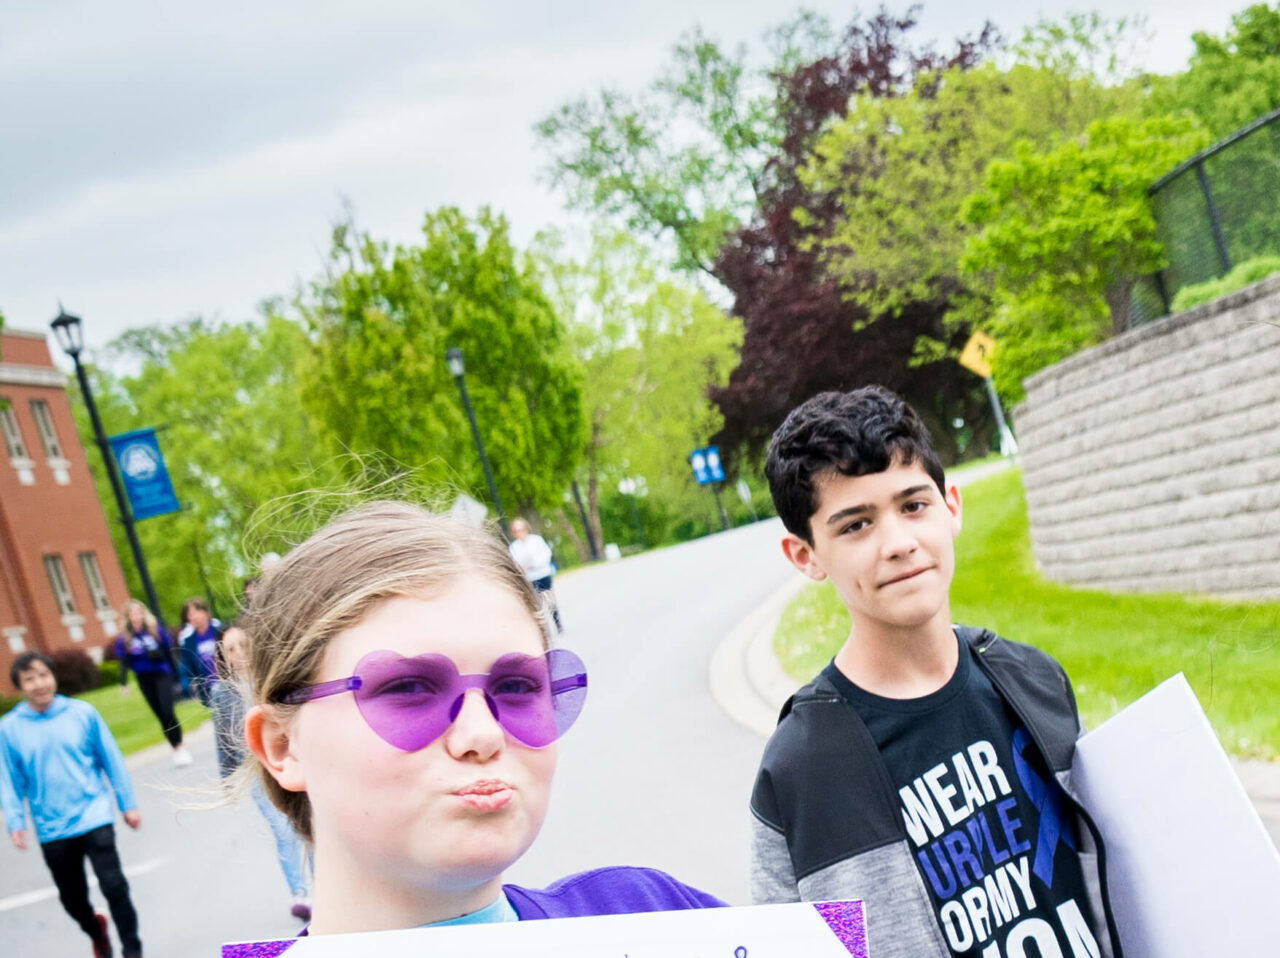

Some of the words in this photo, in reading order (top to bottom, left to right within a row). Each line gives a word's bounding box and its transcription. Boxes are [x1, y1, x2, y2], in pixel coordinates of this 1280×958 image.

[899, 740, 1012, 847] WEAR
[918, 797, 1032, 899] URPLE
[940, 886, 992, 953] OR
[984, 856, 1037, 927] MY
